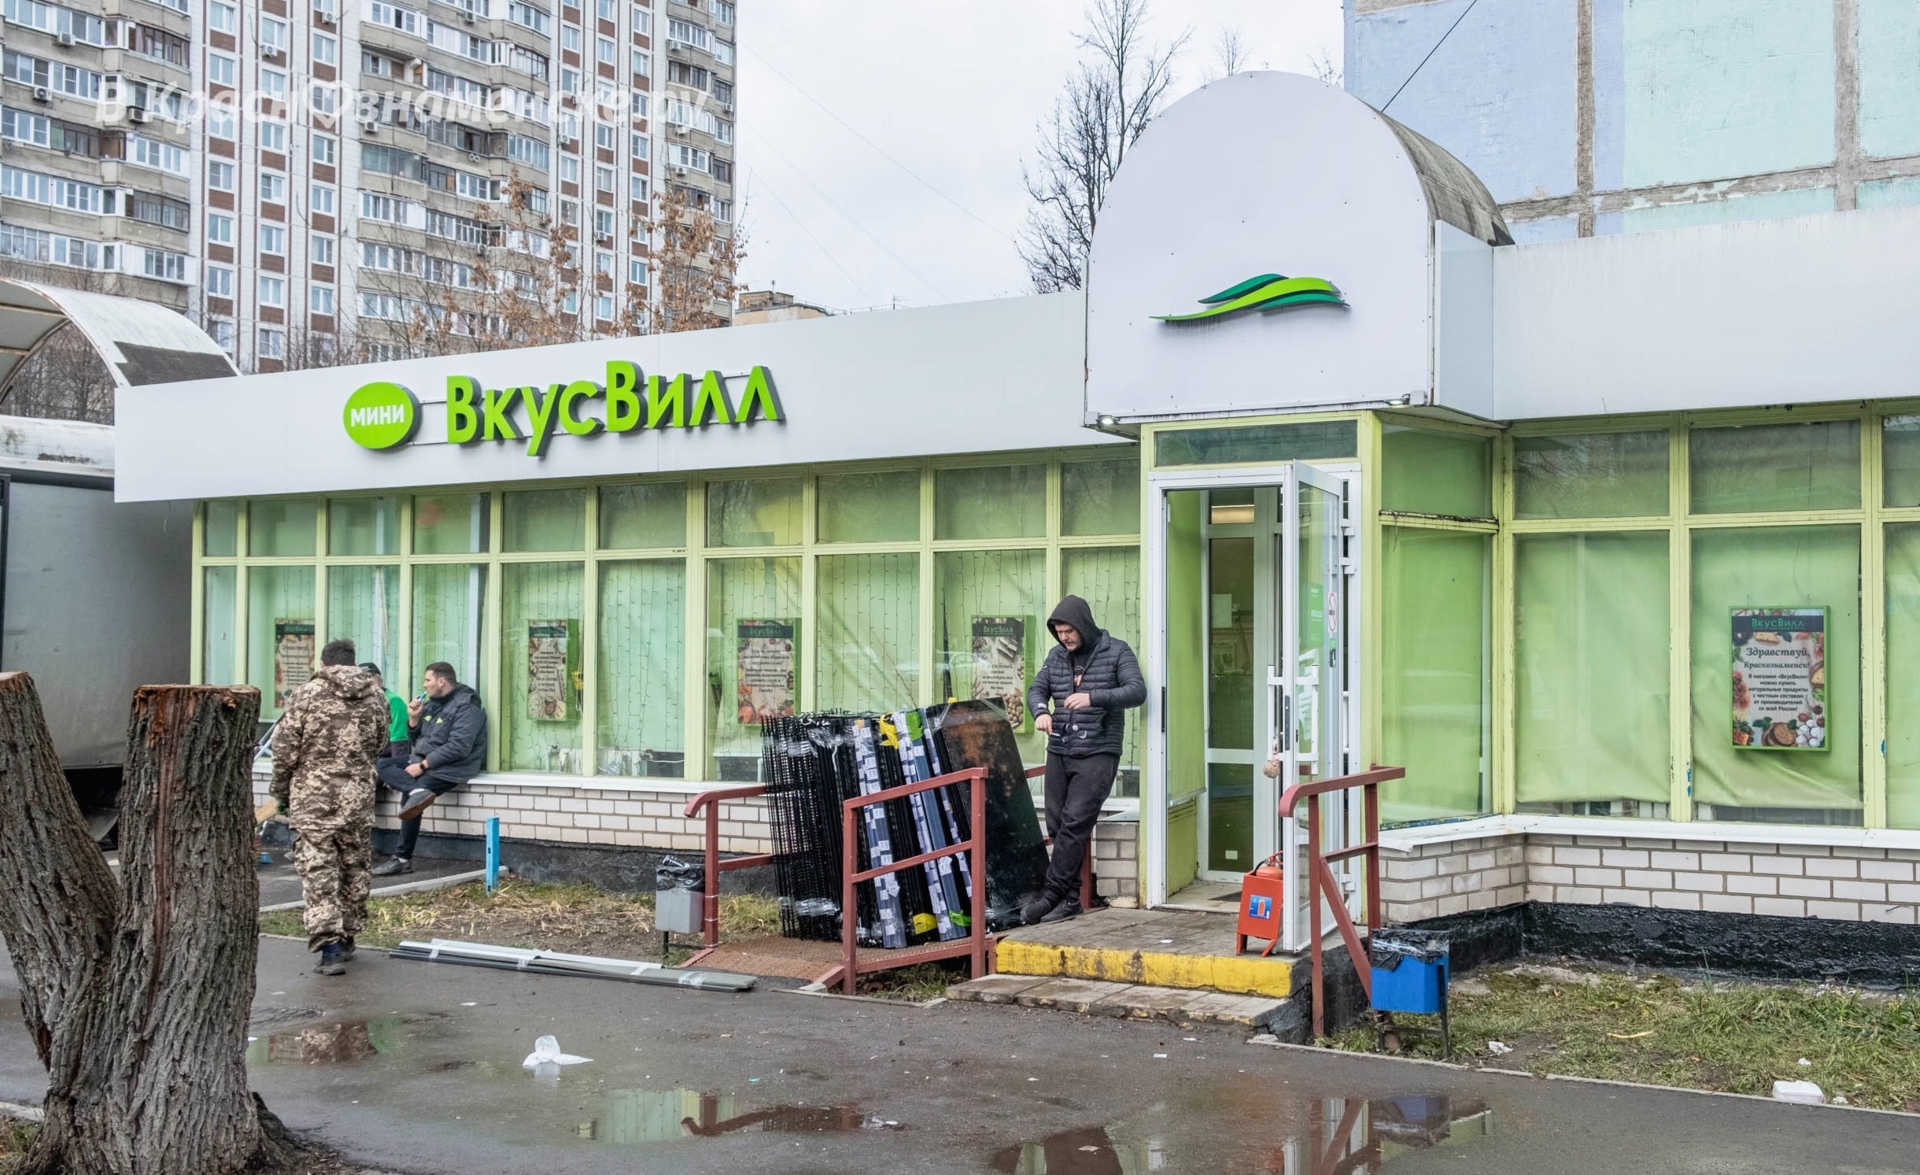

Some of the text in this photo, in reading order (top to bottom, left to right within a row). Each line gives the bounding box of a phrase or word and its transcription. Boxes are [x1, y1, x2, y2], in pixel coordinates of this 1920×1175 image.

[446, 360, 784, 457] ВкусВилл
[1751, 618, 1805, 630] ВкусВилл
[1746, 646, 1811, 659] Здравствуй,
